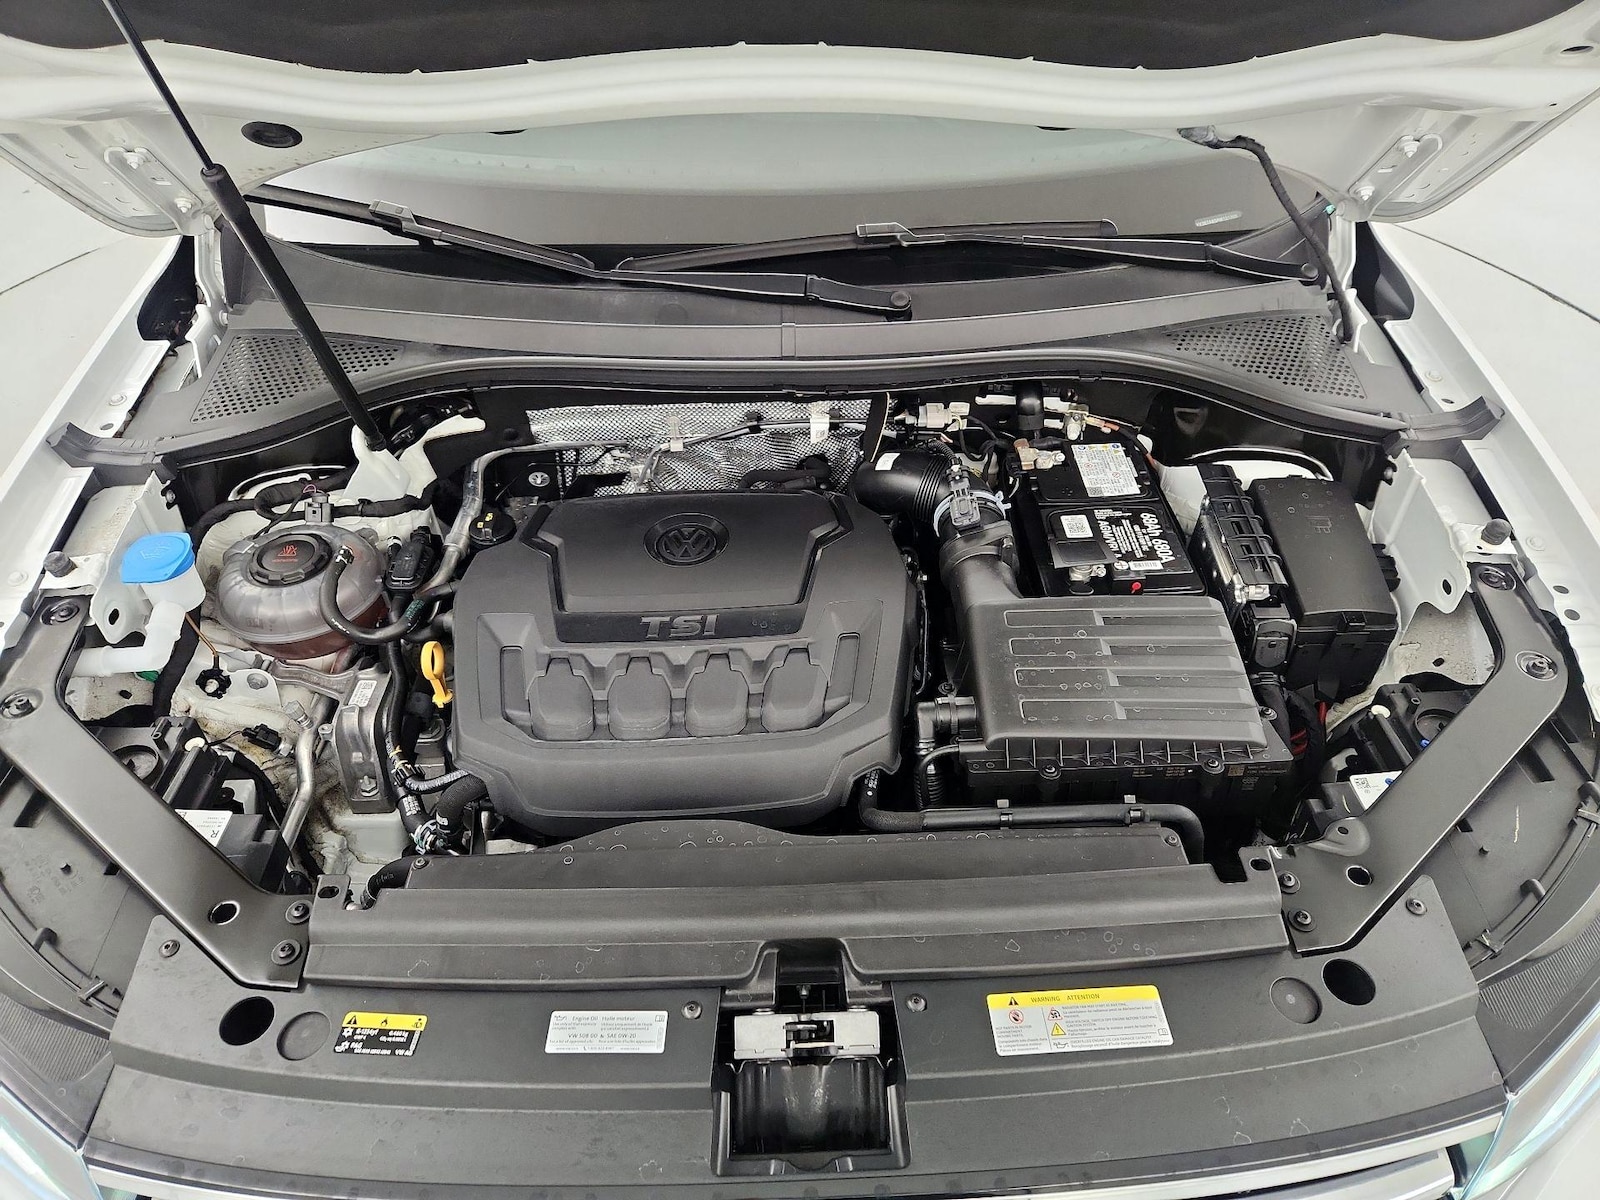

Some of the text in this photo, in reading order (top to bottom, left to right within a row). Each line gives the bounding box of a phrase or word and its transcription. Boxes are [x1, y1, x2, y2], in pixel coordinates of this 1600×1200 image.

[1140, 512, 1163, 537] 68Ah
[1151, 538, 1176, 564] 680A
[640, 613, 720, 639] TSI
[1031, 993, 1100, 1003] WARNING ATTENTION
